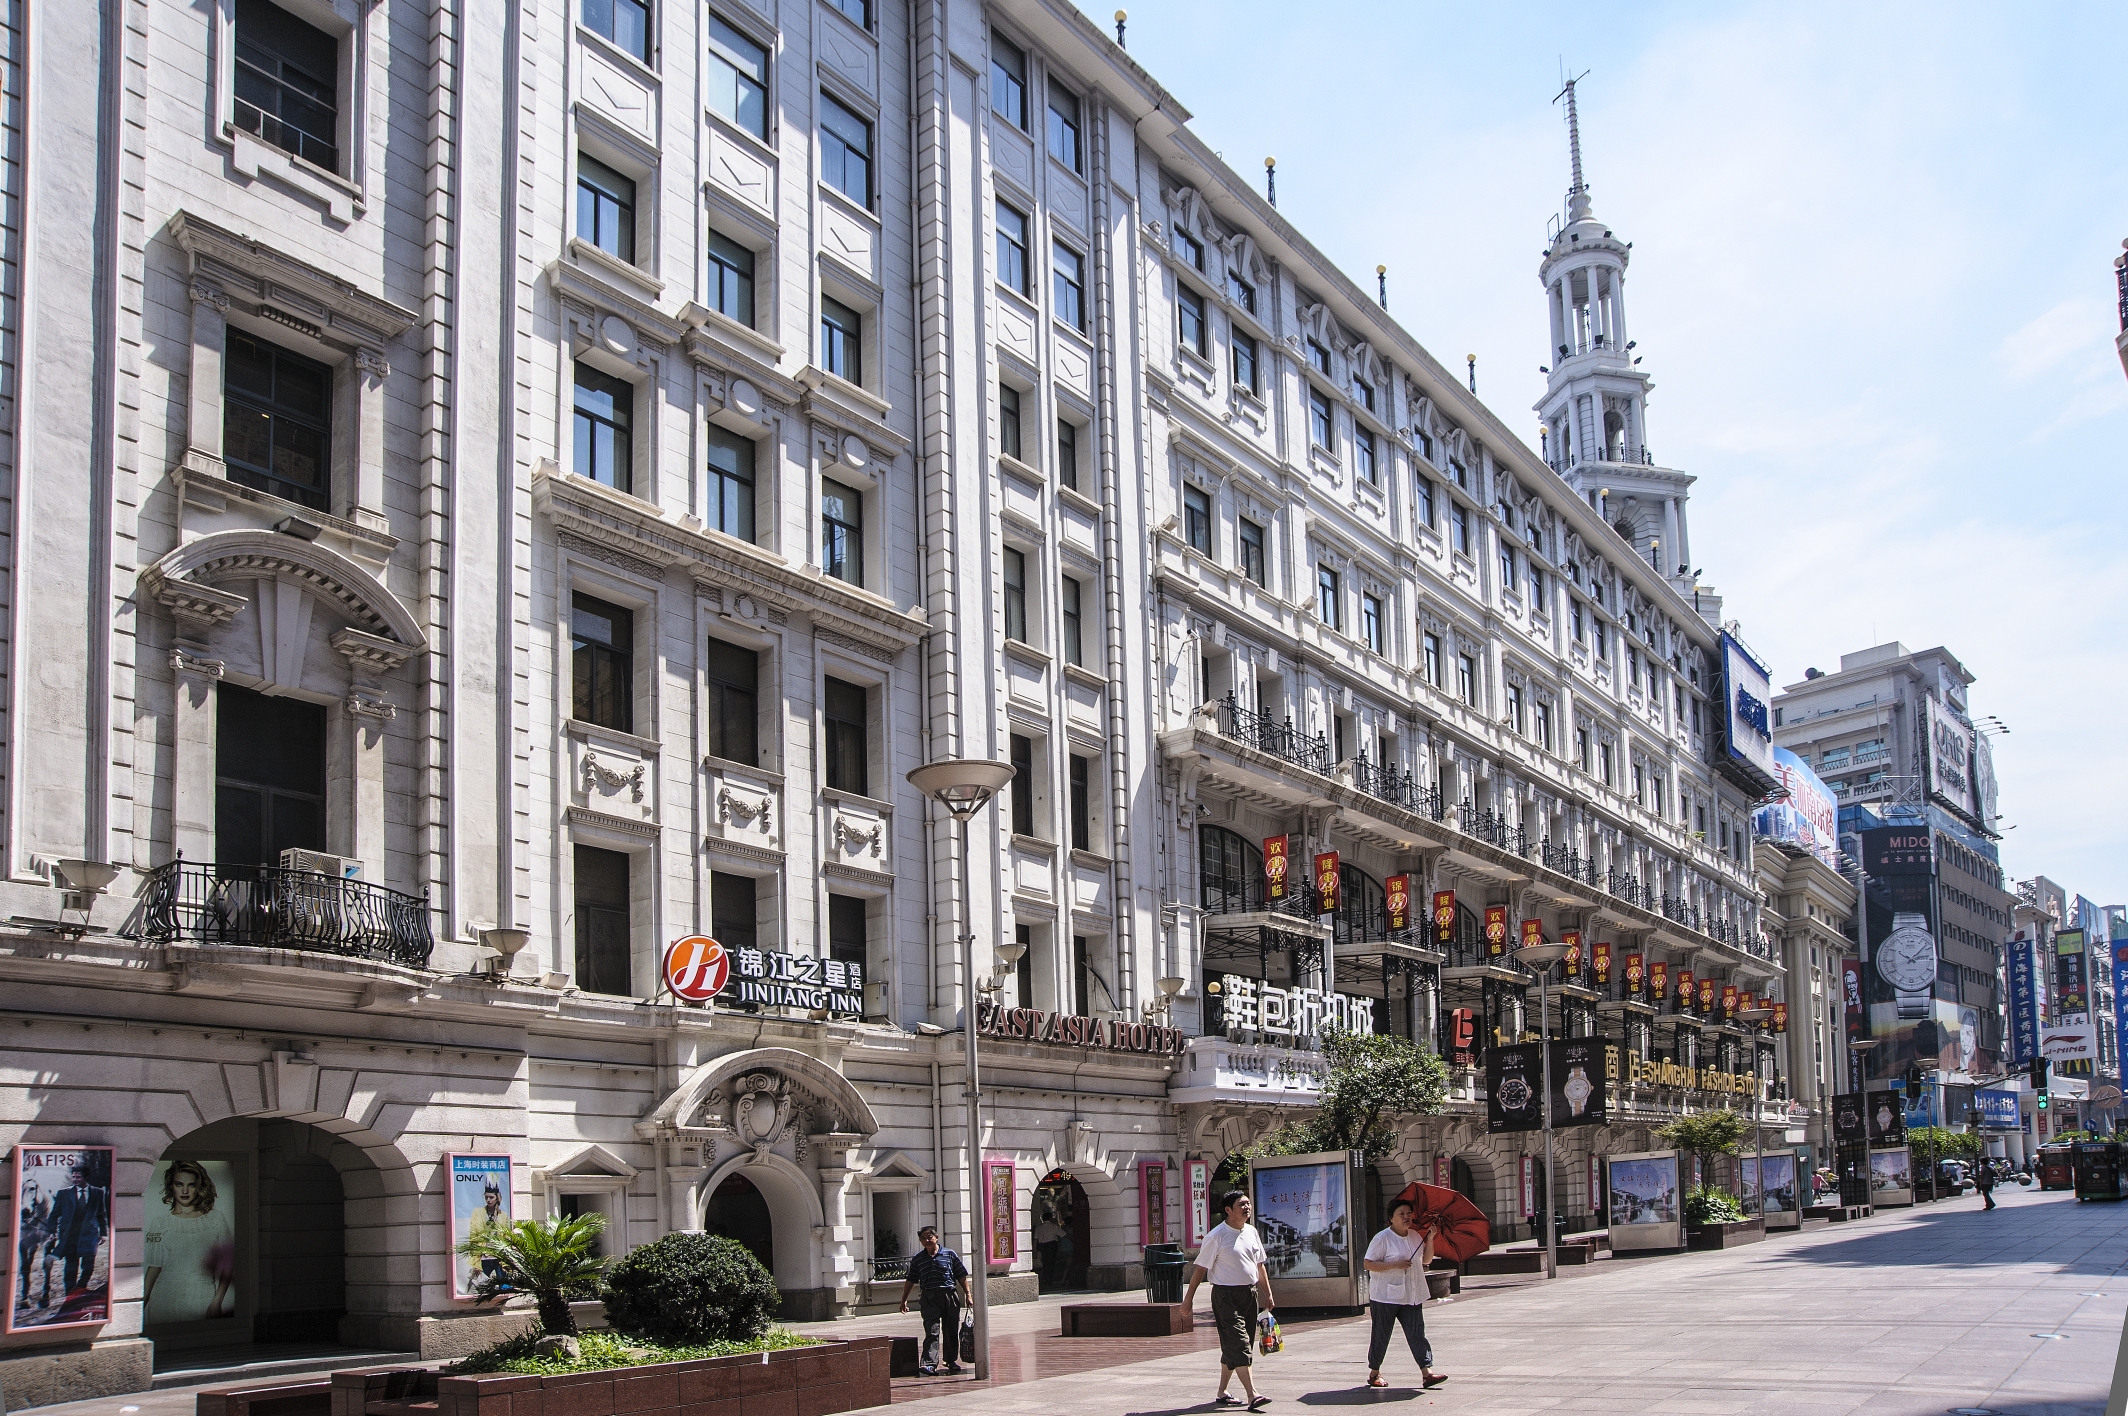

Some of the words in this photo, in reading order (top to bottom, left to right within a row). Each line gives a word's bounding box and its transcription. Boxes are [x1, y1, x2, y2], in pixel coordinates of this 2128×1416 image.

[1936, 718, 1965, 767] ORIS
[1763, 762, 1834, 841] 美丽南京路
[1890, 837, 1930, 848] MIDO
[1270, 842, 1283, 897] 欢迎光临
[1322, 858, 1335, 910] 隆重开业
[1392, 880, 1404, 928] 锦江之星
[1440, 895, 1450, 940] 隆重开业
[1490, 912, 1501, 955] 欢迎光临
[1527, 924, 1537, 948] 隆重
[738, 946, 847, 989] 锦江之星
[849, 962, 862, 990] 酒店
[740, 981, 823, 1009] JINJIANG
[830, 992, 862, 1013] INN
[1224, 974, 1374, 1036] 鞋包折扣城
[975, 1002, 1044, 1040] EAST
[1045, 1012, 1107, 1049] ASIA
[1110, 1020, 1187, 1056] HOTEL
[1644, 1061, 1697, 1088] SHANGHAI
[1702, 1068, 1736, 1092] FASHION
[1737, 1074, 1763, 1097] STO
[46, 1154, 75, 1167] FIRS
[455, 1160, 505, 1170] 上海时装商店
[456, 1174, 483, 1182] ONLY
